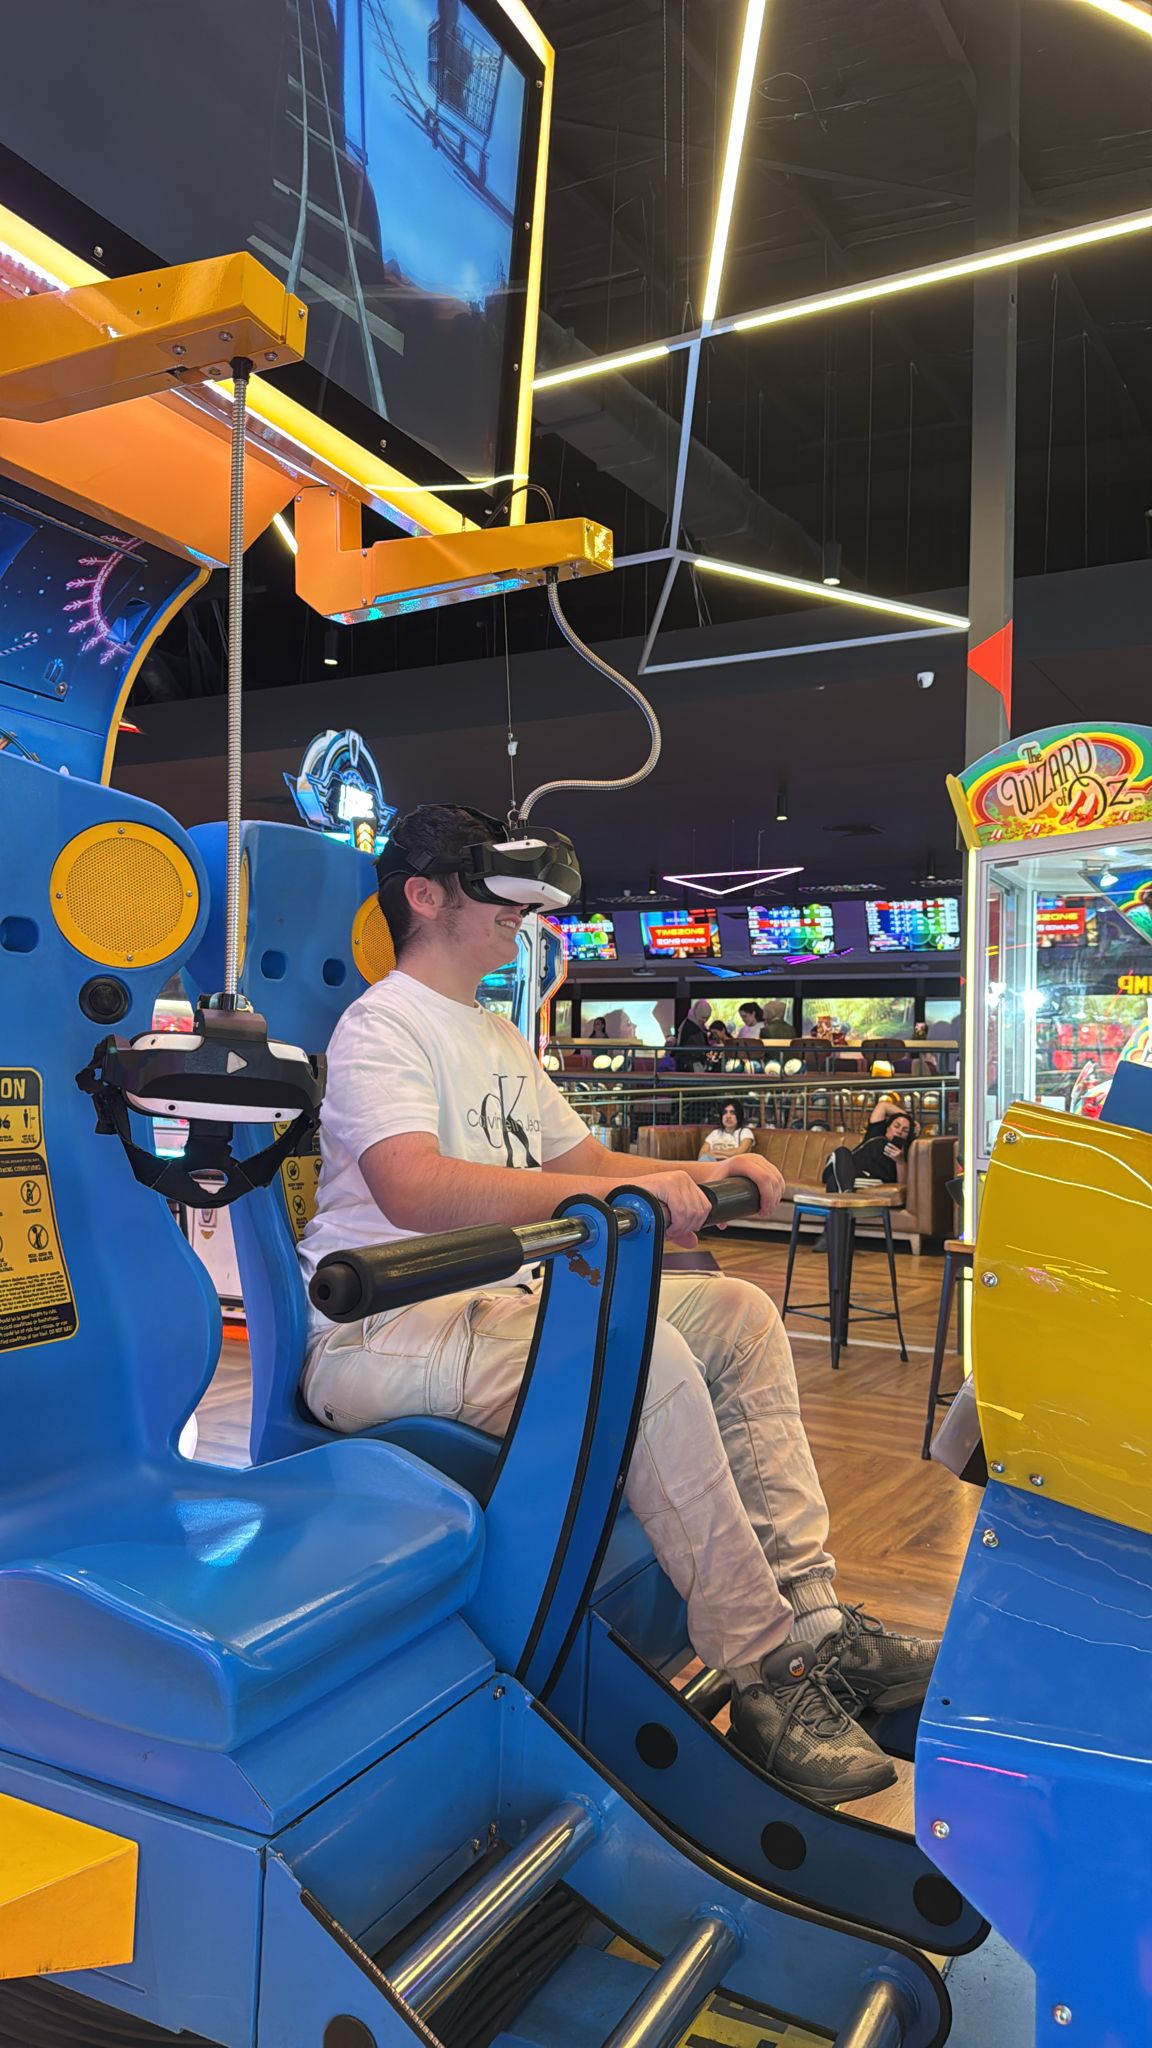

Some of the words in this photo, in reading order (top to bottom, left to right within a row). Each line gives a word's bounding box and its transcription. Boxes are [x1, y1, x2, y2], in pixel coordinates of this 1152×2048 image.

[1021, 746, 1042, 763] The
[1001, 737, 1092, 816] WIZARD
[1055, 787, 1068, 807] of
